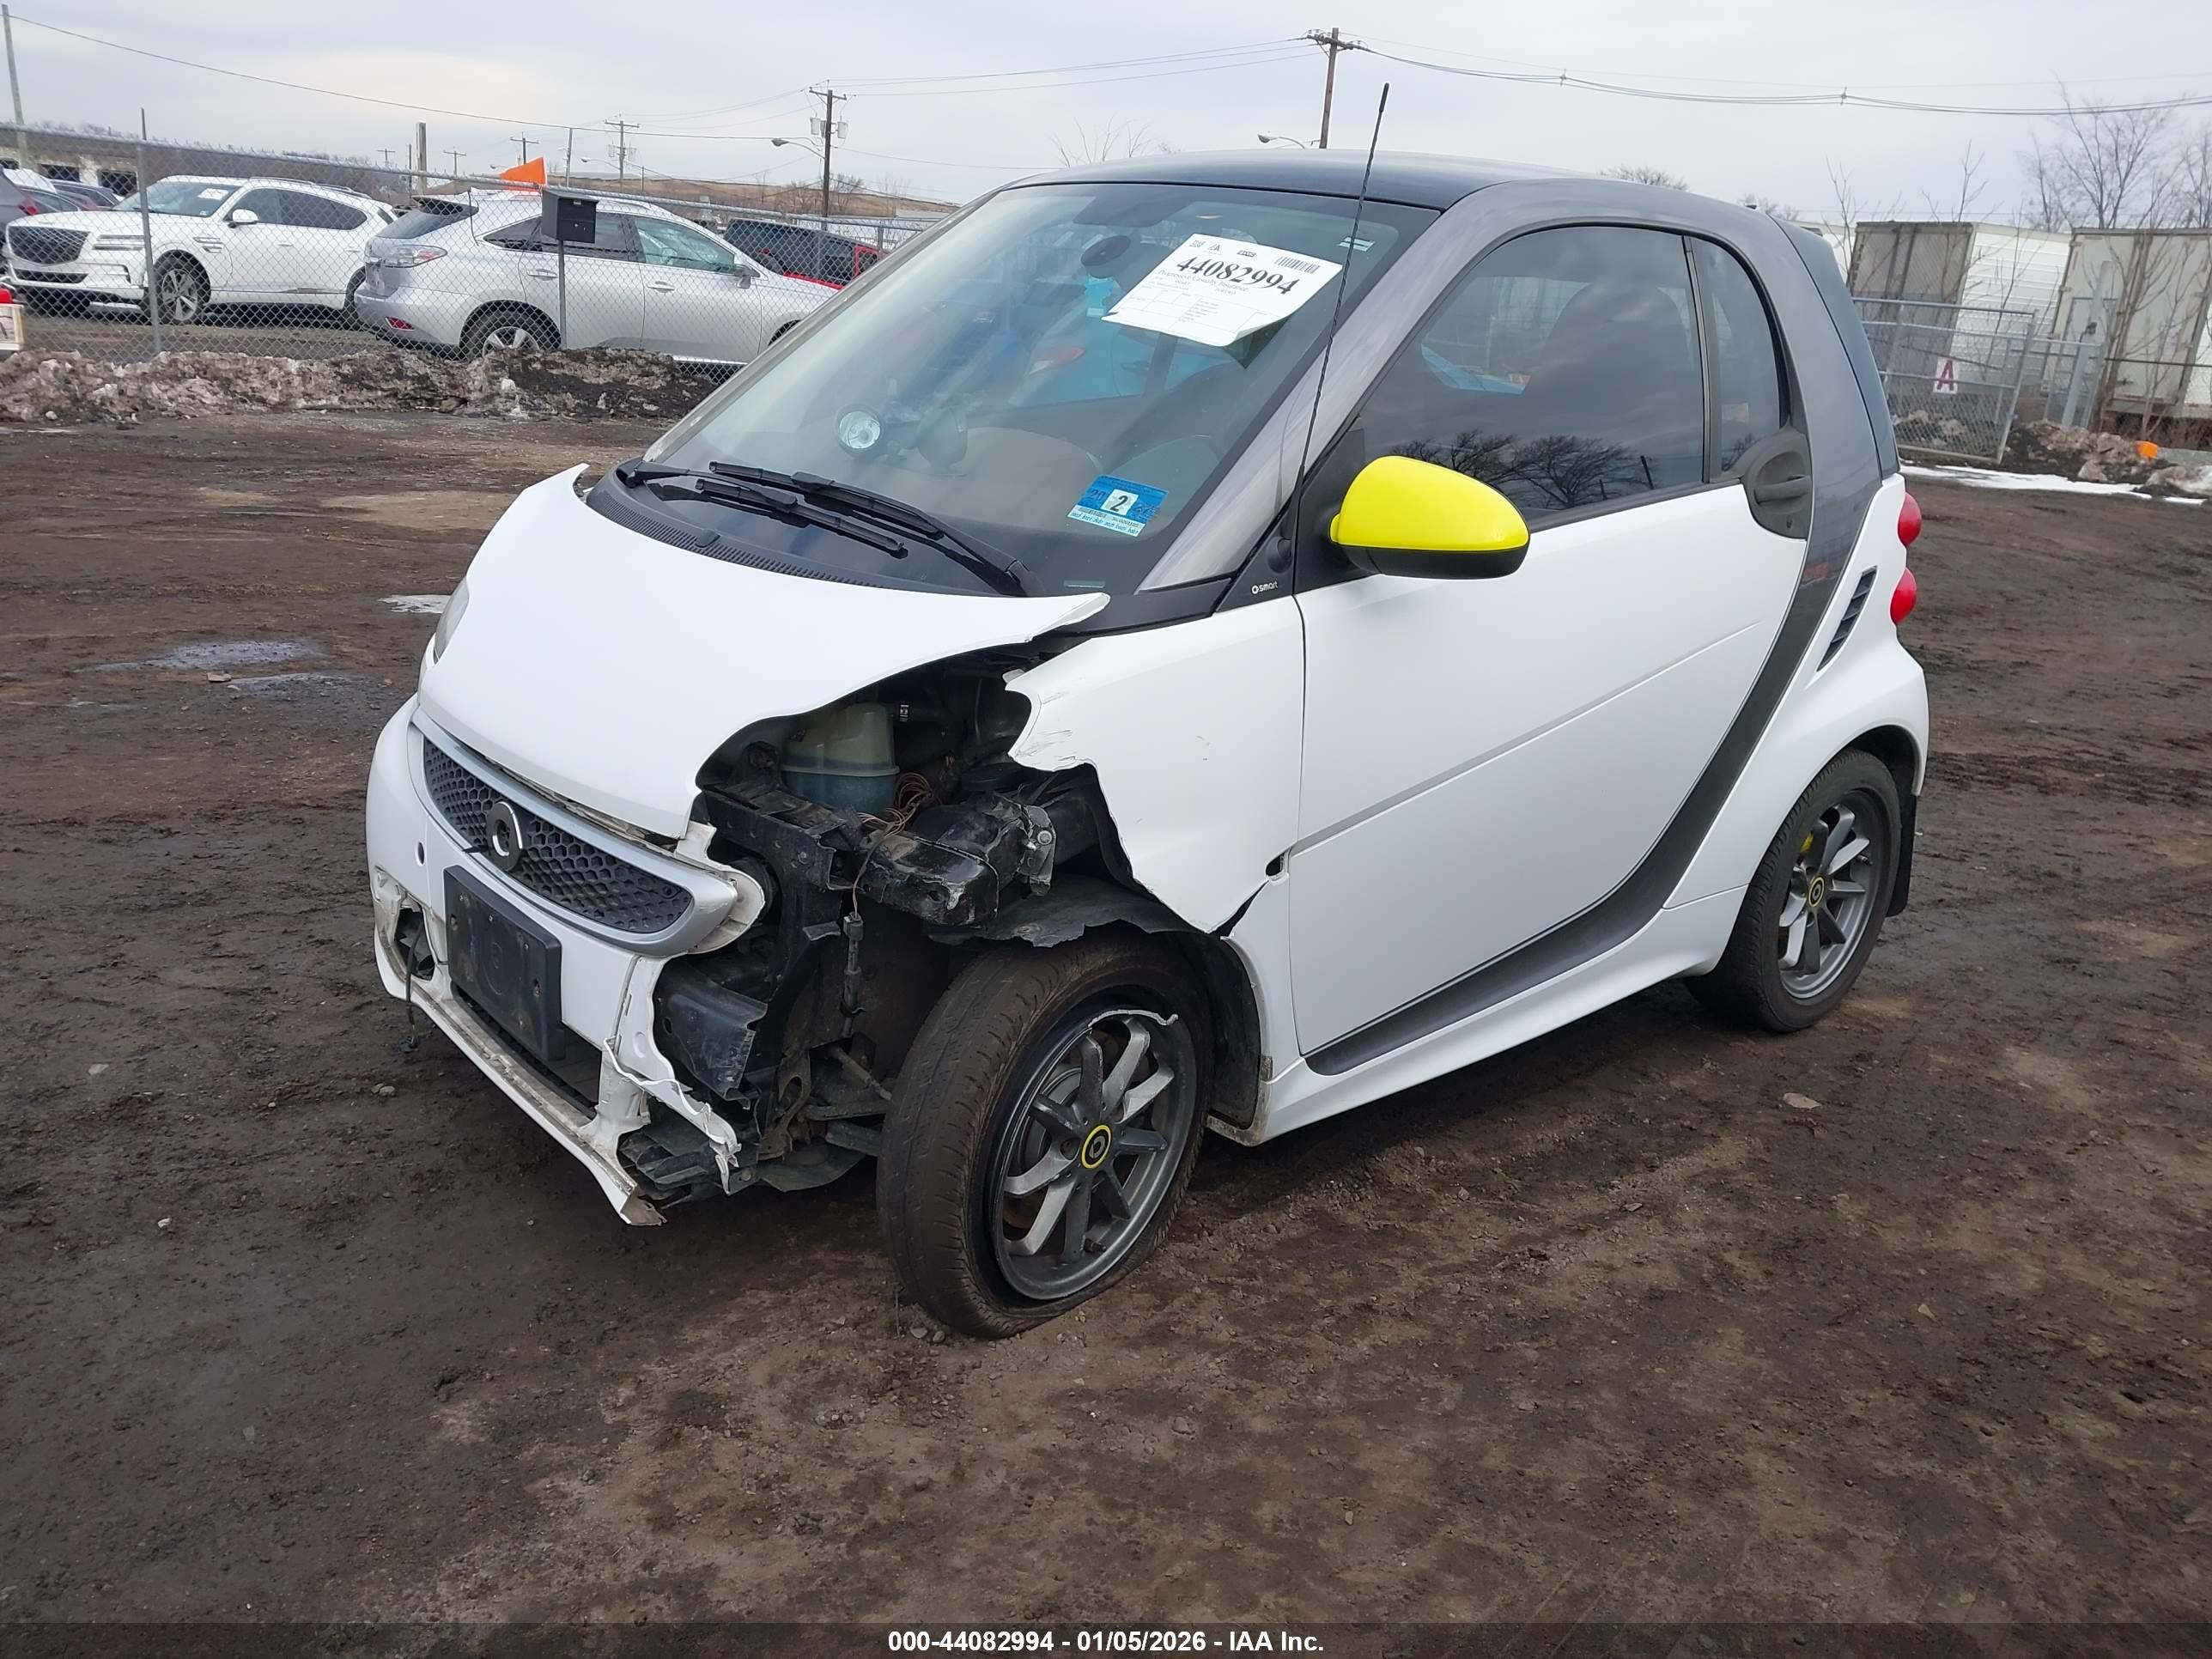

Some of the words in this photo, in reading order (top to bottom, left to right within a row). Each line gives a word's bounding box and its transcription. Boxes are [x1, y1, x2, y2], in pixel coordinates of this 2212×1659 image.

[1176, 256, 1300, 295] 44082994
[1936, 359, 1954, 391] A
[1109, 495, 1128, 512] 2
[1259, 580, 1279, 592] smart
